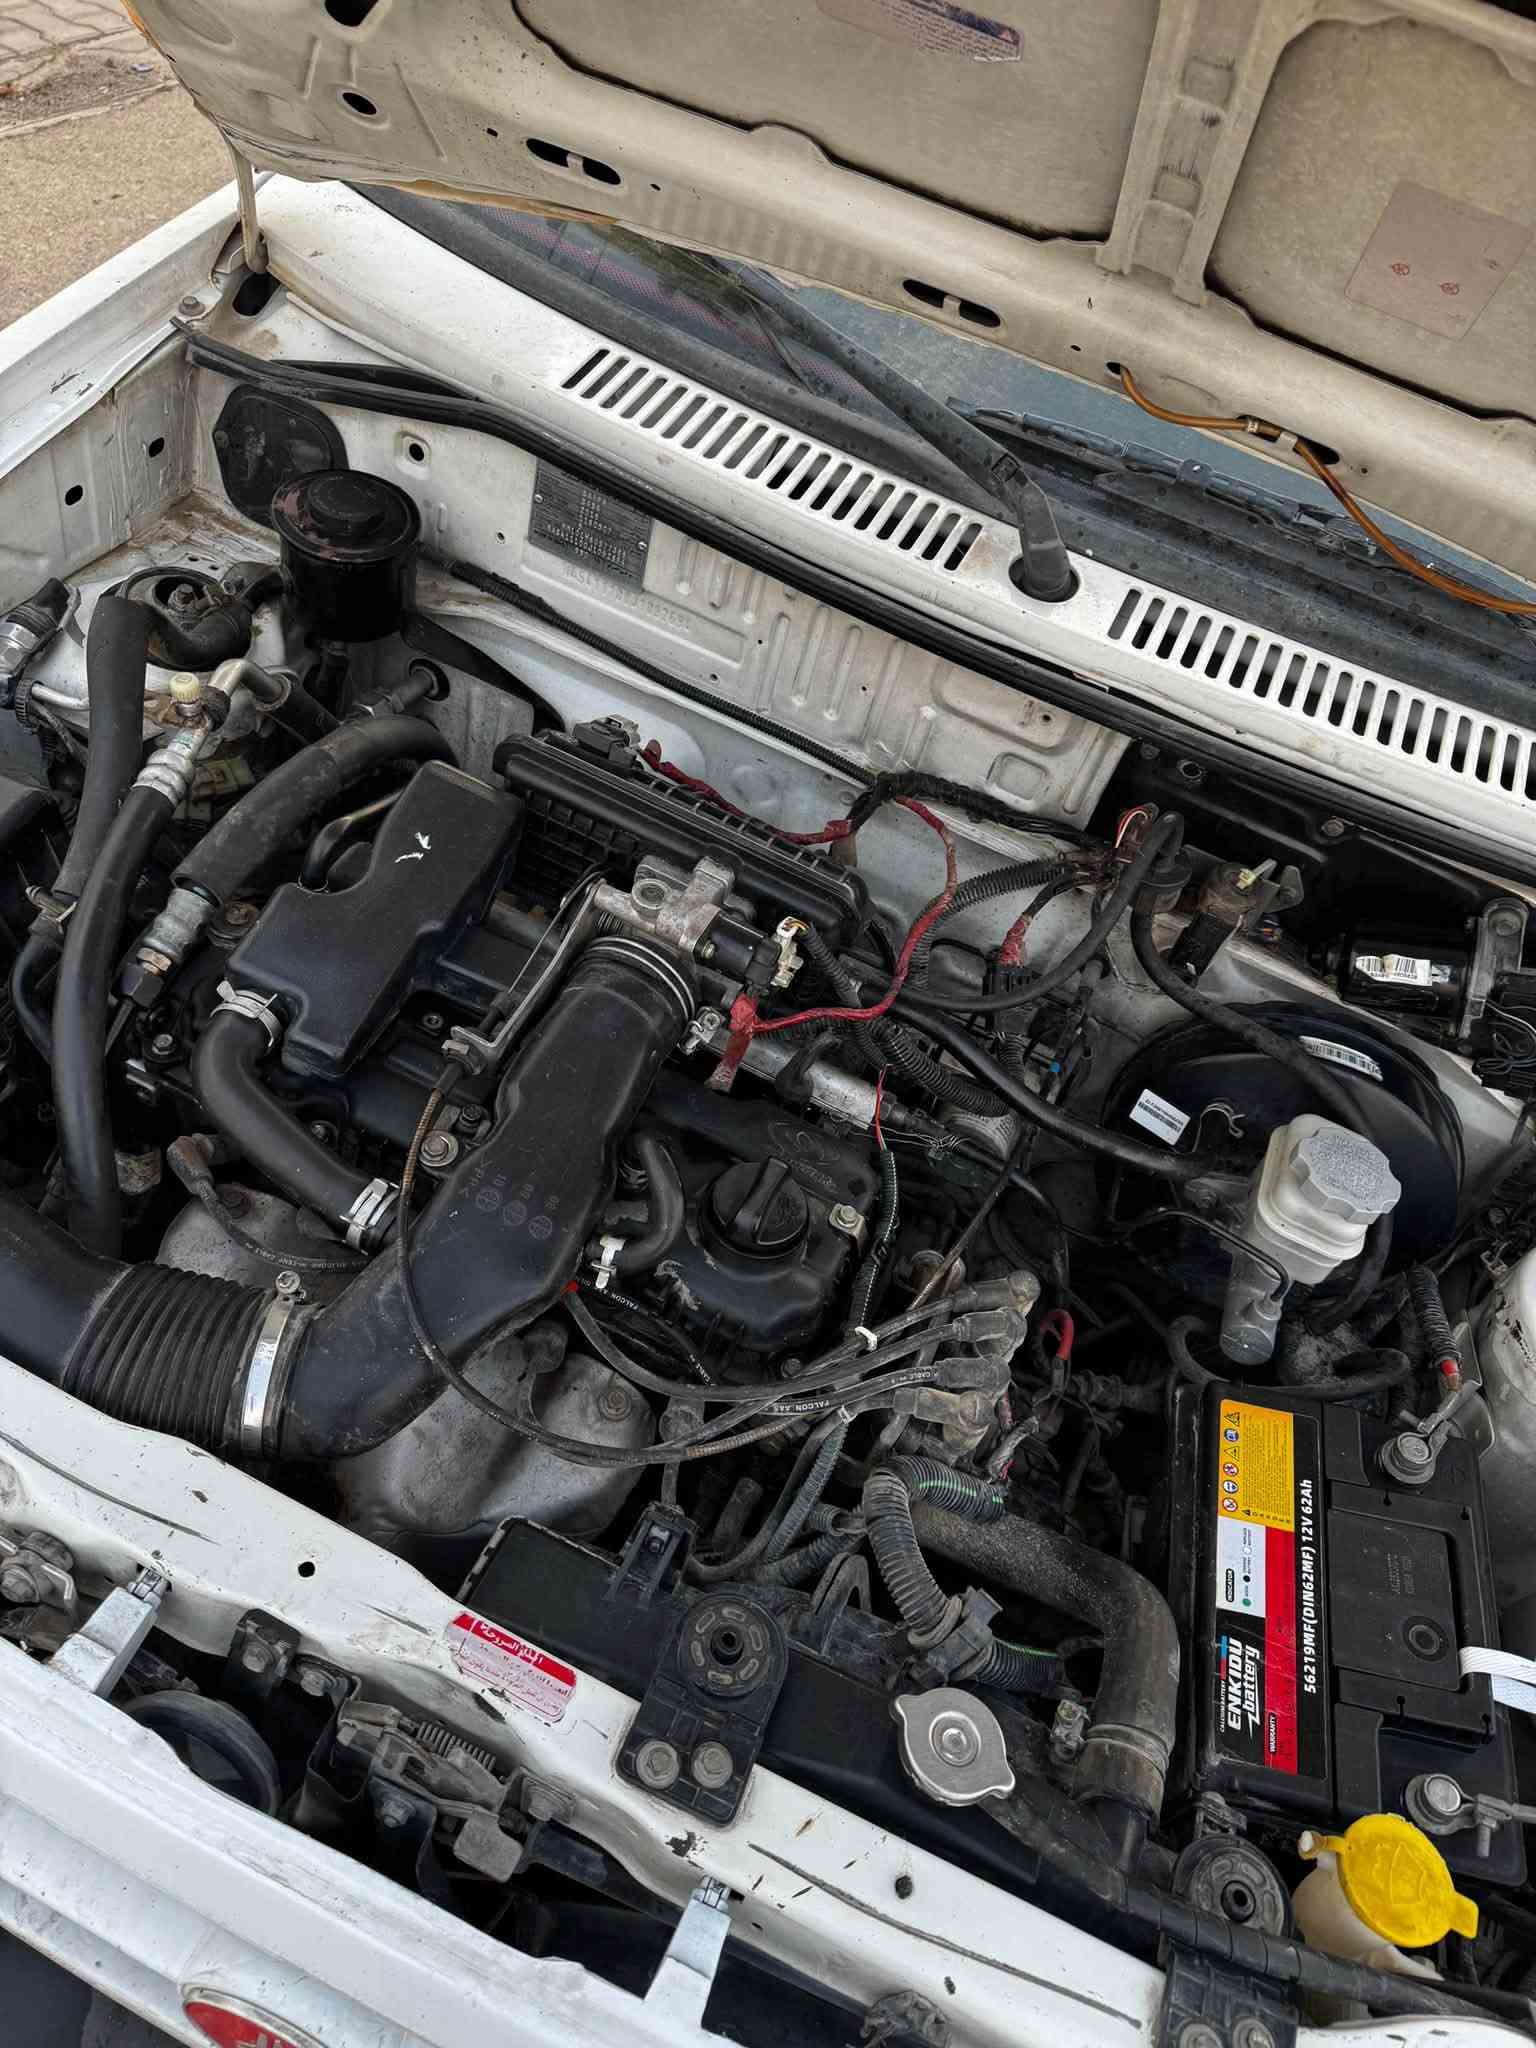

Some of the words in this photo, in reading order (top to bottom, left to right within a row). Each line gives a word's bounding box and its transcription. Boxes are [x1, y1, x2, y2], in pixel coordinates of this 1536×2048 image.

[795, 1399, 830, 1412] FALCON
[1300, 1479, 1313, 1514] 62Ah
[1301, 1516, 1314, 1543] 12V
[1226, 1569, 1234, 1601] INDICATOR
[1300, 1546, 1317, 1695] 56219MF(DIN62MF)
[1219, 1679, 1227, 1705] BATTERY
[1227, 1636, 1243, 1731] ENKIDU
[1242, 1643, 1261, 1713] battery
